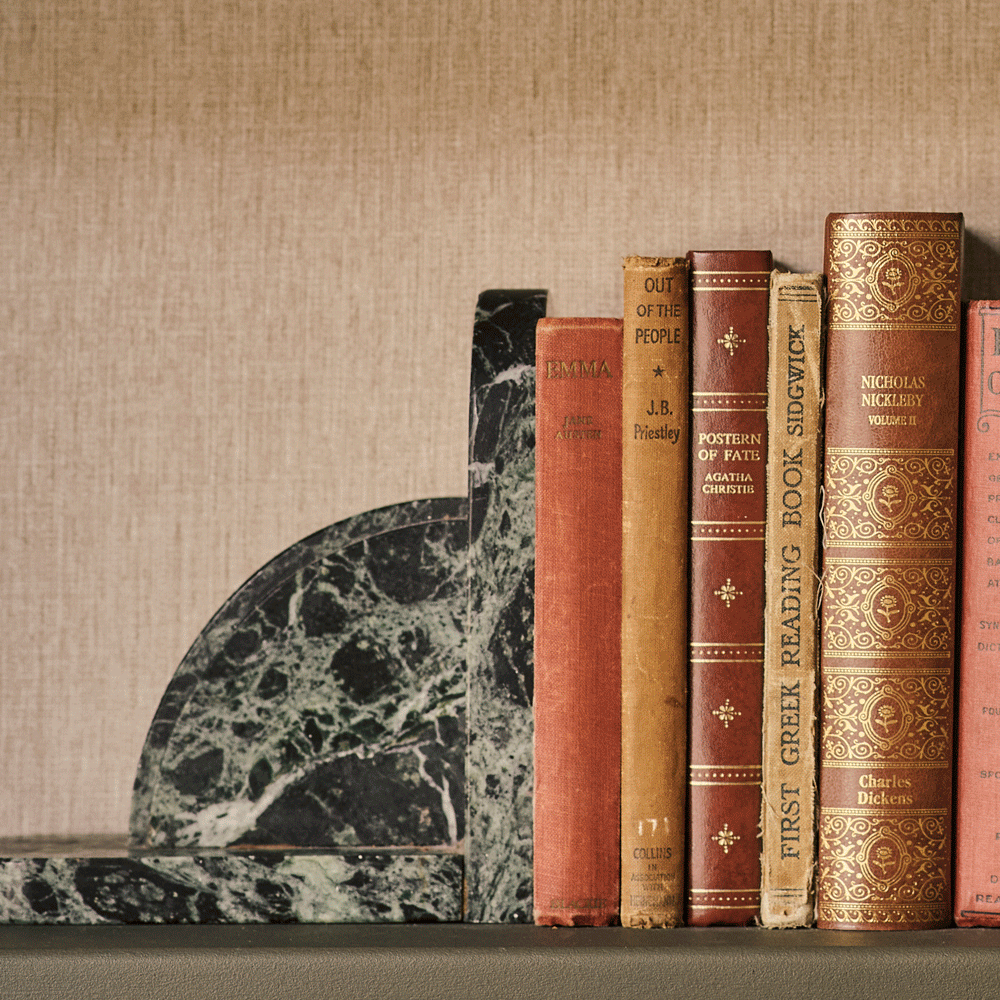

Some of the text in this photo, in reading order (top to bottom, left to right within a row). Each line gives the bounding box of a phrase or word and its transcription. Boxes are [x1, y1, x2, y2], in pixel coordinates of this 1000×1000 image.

[644, 277, 674, 294] OUT
[637, 304, 681, 318] OF THE
[635, 329, 681, 345] PEOPLE
[546, 360, 613, 379] EMMA
[860, 375, 925, 389] NICHOLAS
[860, 393, 924, 408] NICKLEBY
[646, 400, 674, 416] J.B.
[563, 416, 593, 428] JANE
[868, 414, 917, 426] VOLUME II
[554, 430, 602, 440] AUSTEN
[634, 424, 680, 445] Priestley
[698, 433, 761, 447] POSTERN
[698, 448, 760, 461] OF FATE
[705, 473, 753, 483] AGATHA
[702, 484, 755, 495] CHRISTIE
[780, 324, 806, 860] FIRST GREEK READING BOOK SIDGWICK
[858, 774, 911, 789] Charles
[857, 791, 913, 806] Dickens
[634, 847, 672, 859] COLLINS
